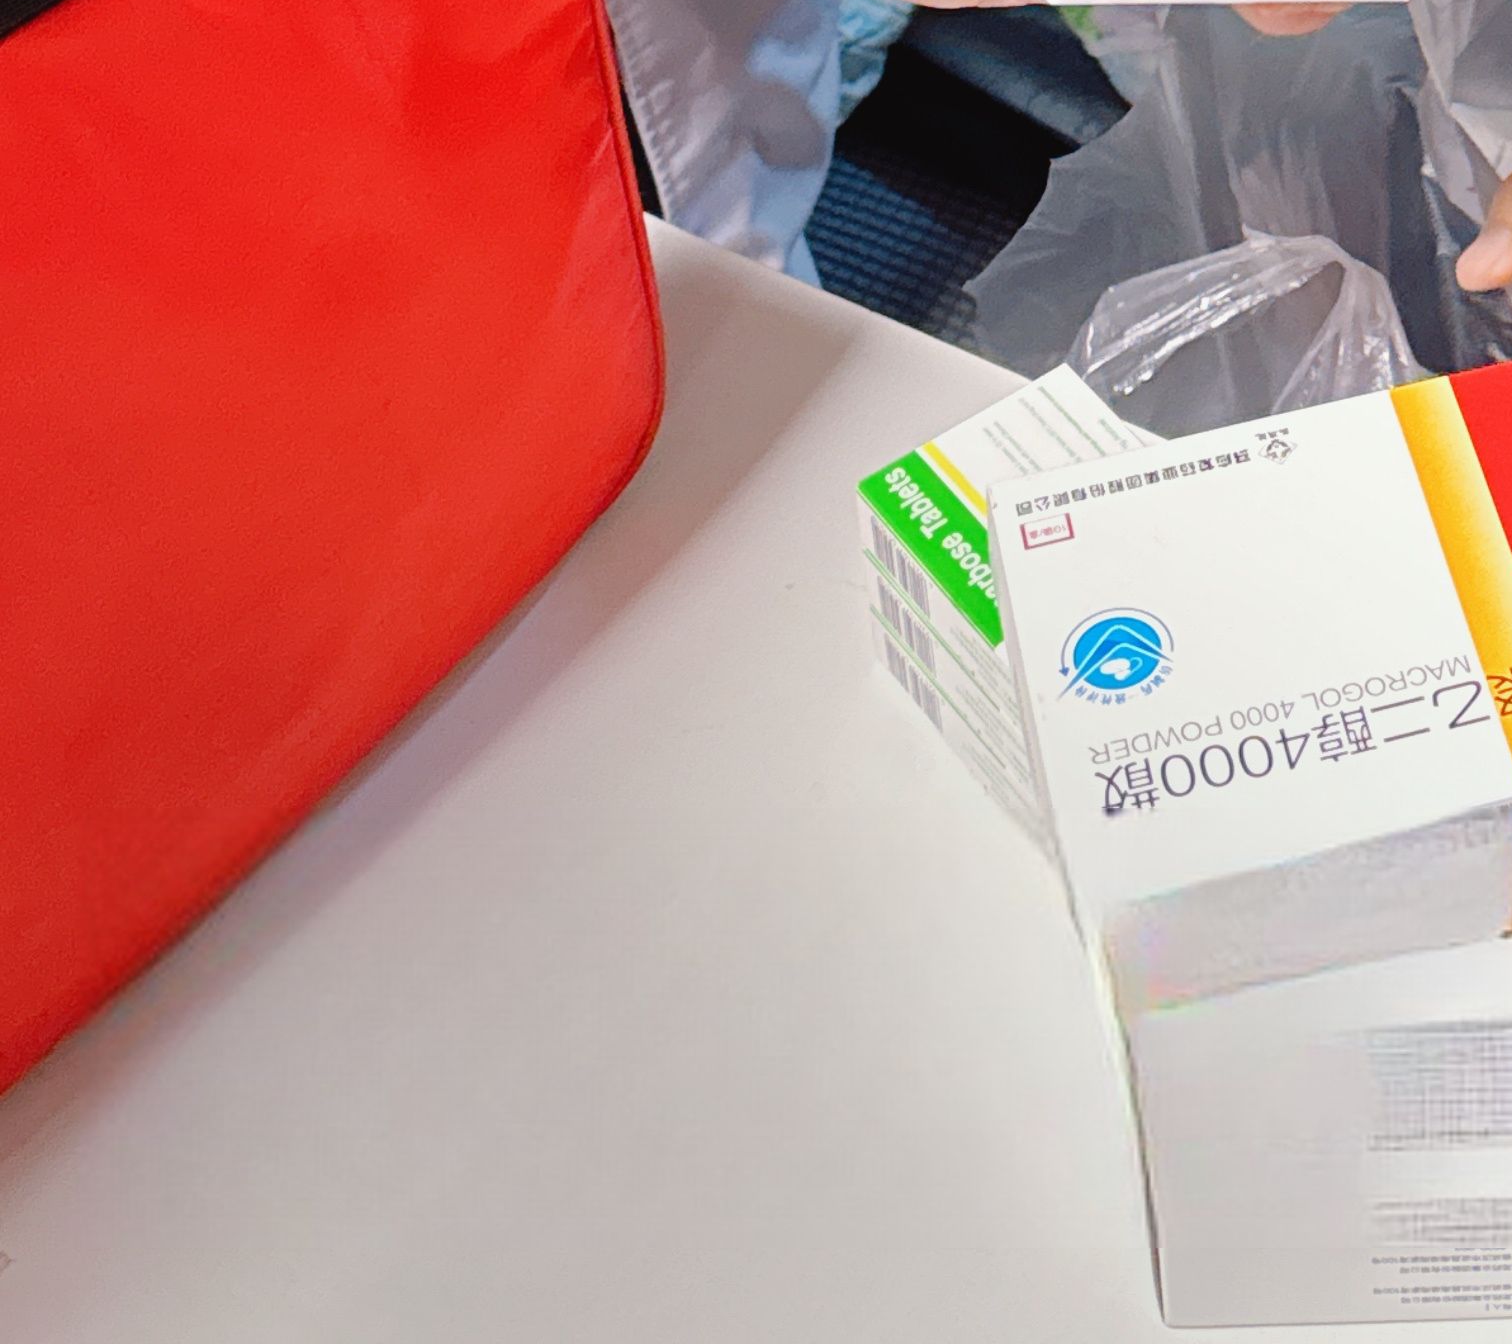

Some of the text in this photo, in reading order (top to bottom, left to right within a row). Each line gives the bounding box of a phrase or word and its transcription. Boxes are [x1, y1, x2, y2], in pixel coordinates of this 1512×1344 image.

[884, 466, 948, 540] Tablets
[1302, 654, 1472, 709] MACROGOL
[1088, 714, 1223, 766] POWDER
[1231, 699, 1296, 731] 4000
